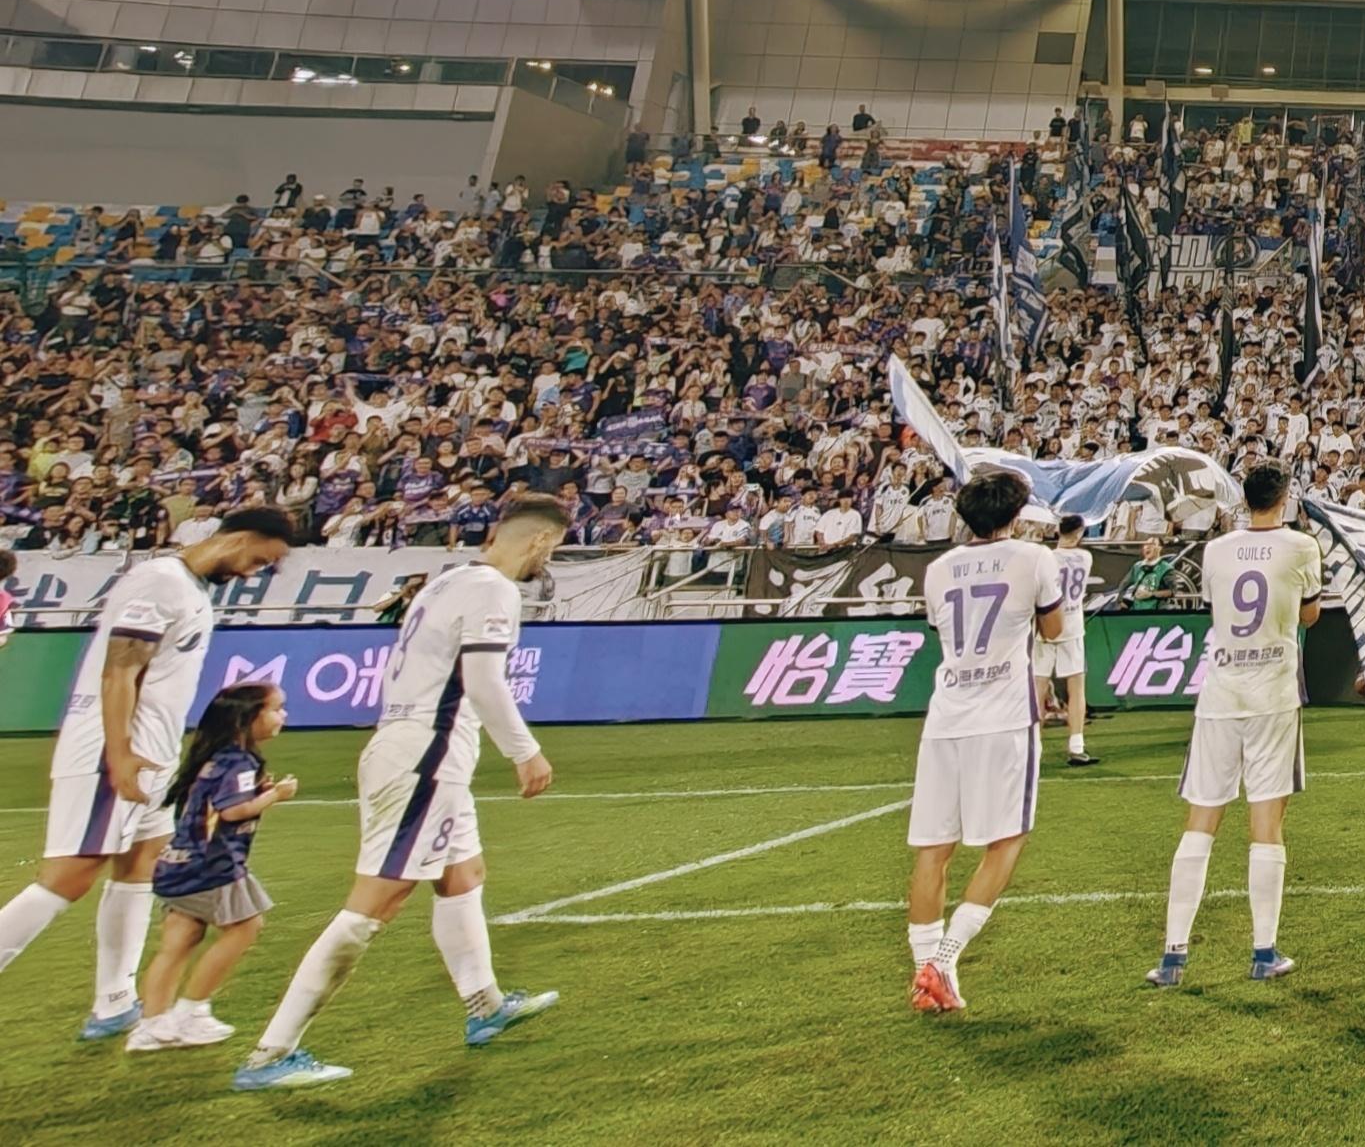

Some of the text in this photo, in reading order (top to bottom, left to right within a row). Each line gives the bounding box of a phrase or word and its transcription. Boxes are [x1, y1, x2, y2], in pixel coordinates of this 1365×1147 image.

[952, 564, 970, 579] WU
[1236, 546, 1273, 561] QUILES
[1059, 567, 1086, 601] 18
[944, 582, 1010, 657] 17
[1230, 569, 1269, 638] 9
[743, 629, 926, 706] 怡寶
[432, 816, 455, 852] 8
